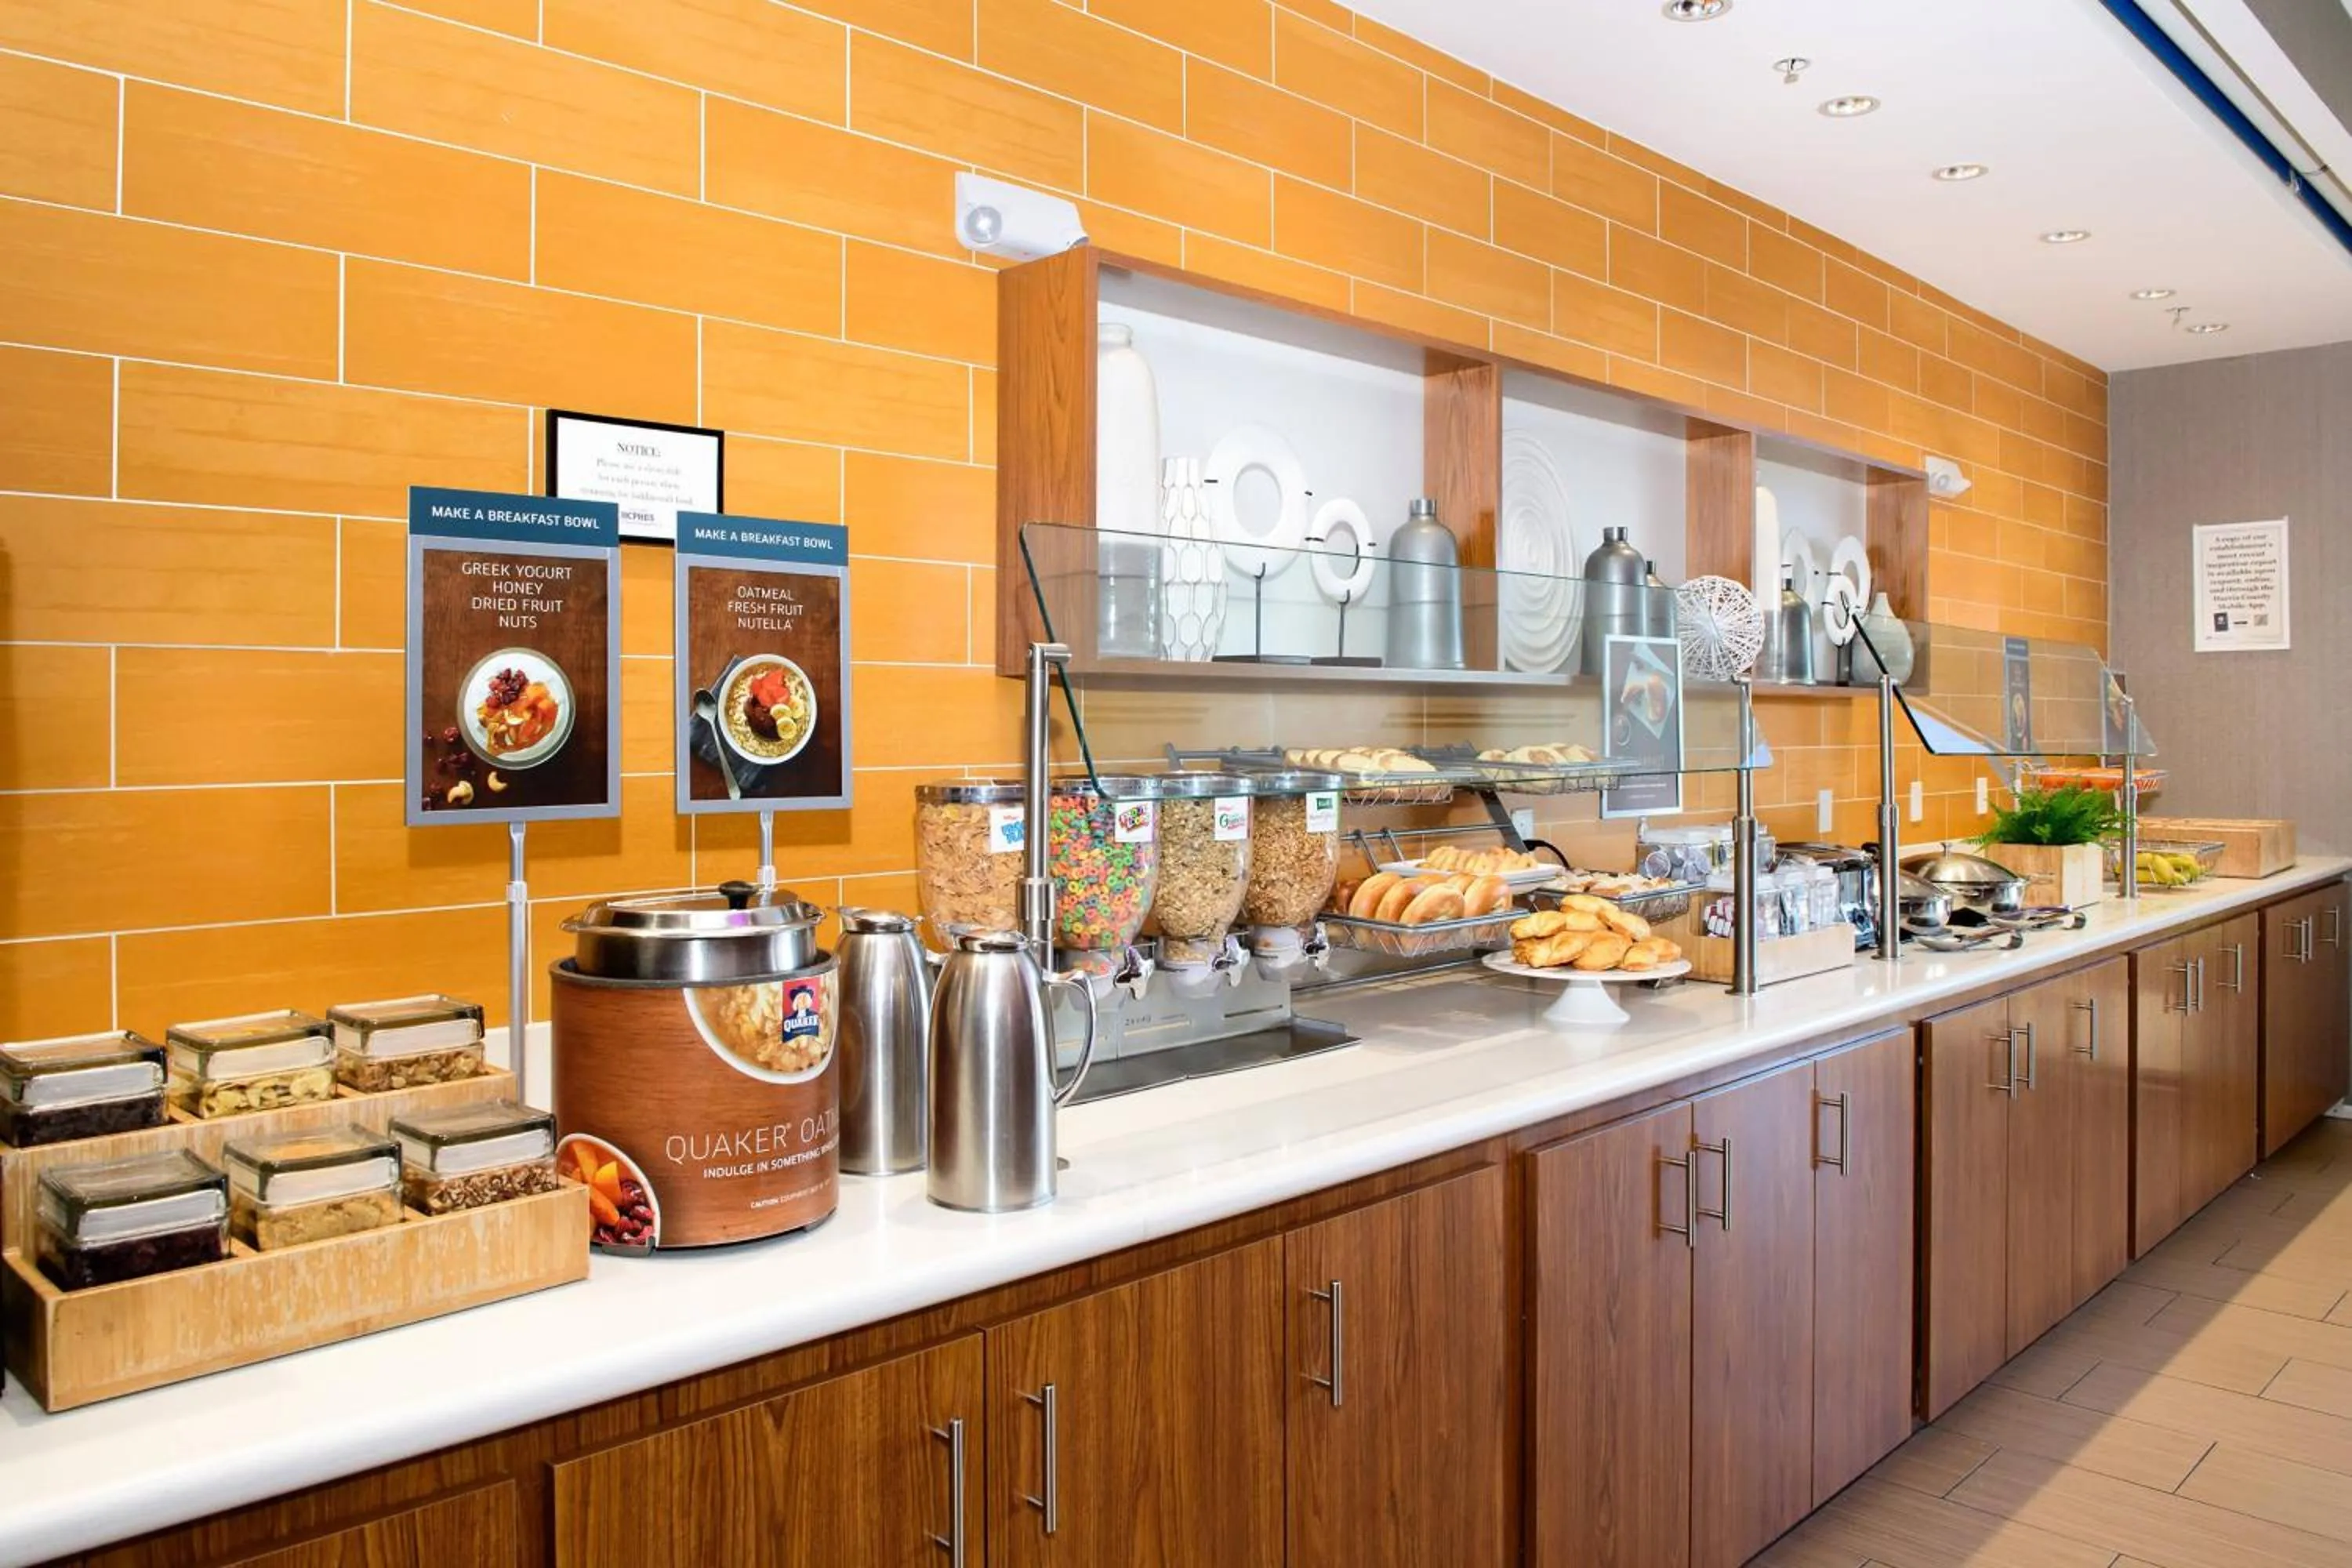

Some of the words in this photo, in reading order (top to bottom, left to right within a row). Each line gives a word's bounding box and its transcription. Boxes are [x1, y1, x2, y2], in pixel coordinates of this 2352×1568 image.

[617, 442, 662, 457] NOTICE:
[432, 506, 470, 520] MAKE
[474, 510, 484, 521] A
[488, 510, 561, 527] BREAKFAST
[564, 515, 600, 529] BOWL
[695, 528, 727, 540] MAKE
[730, 532, 738, 542] A
[741, 532, 800, 546] BREAKFAST
[804, 537, 833, 550] BOWL
[462, 561, 510, 576] GREEK
[516, 564, 572, 579] YOGURT
[492, 581, 543, 595] HONEY
[738, 586, 794, 601] OATMEAL
[471, 597, 517, 612] DRIED
[522, 598, 564, 612] FRUIT
[728, 601, 767, 614] FRESH
[771, 603, 804, 615] FRUIT
[499, 615, 538, 628] NUTS
[800, 1108, 838, 1143] OAT
[702, 1163, 753, 1179] INDULGE
[757, 1160, 768, 1172] IN
[771, 1146, 821, 1171] SOMETHING
